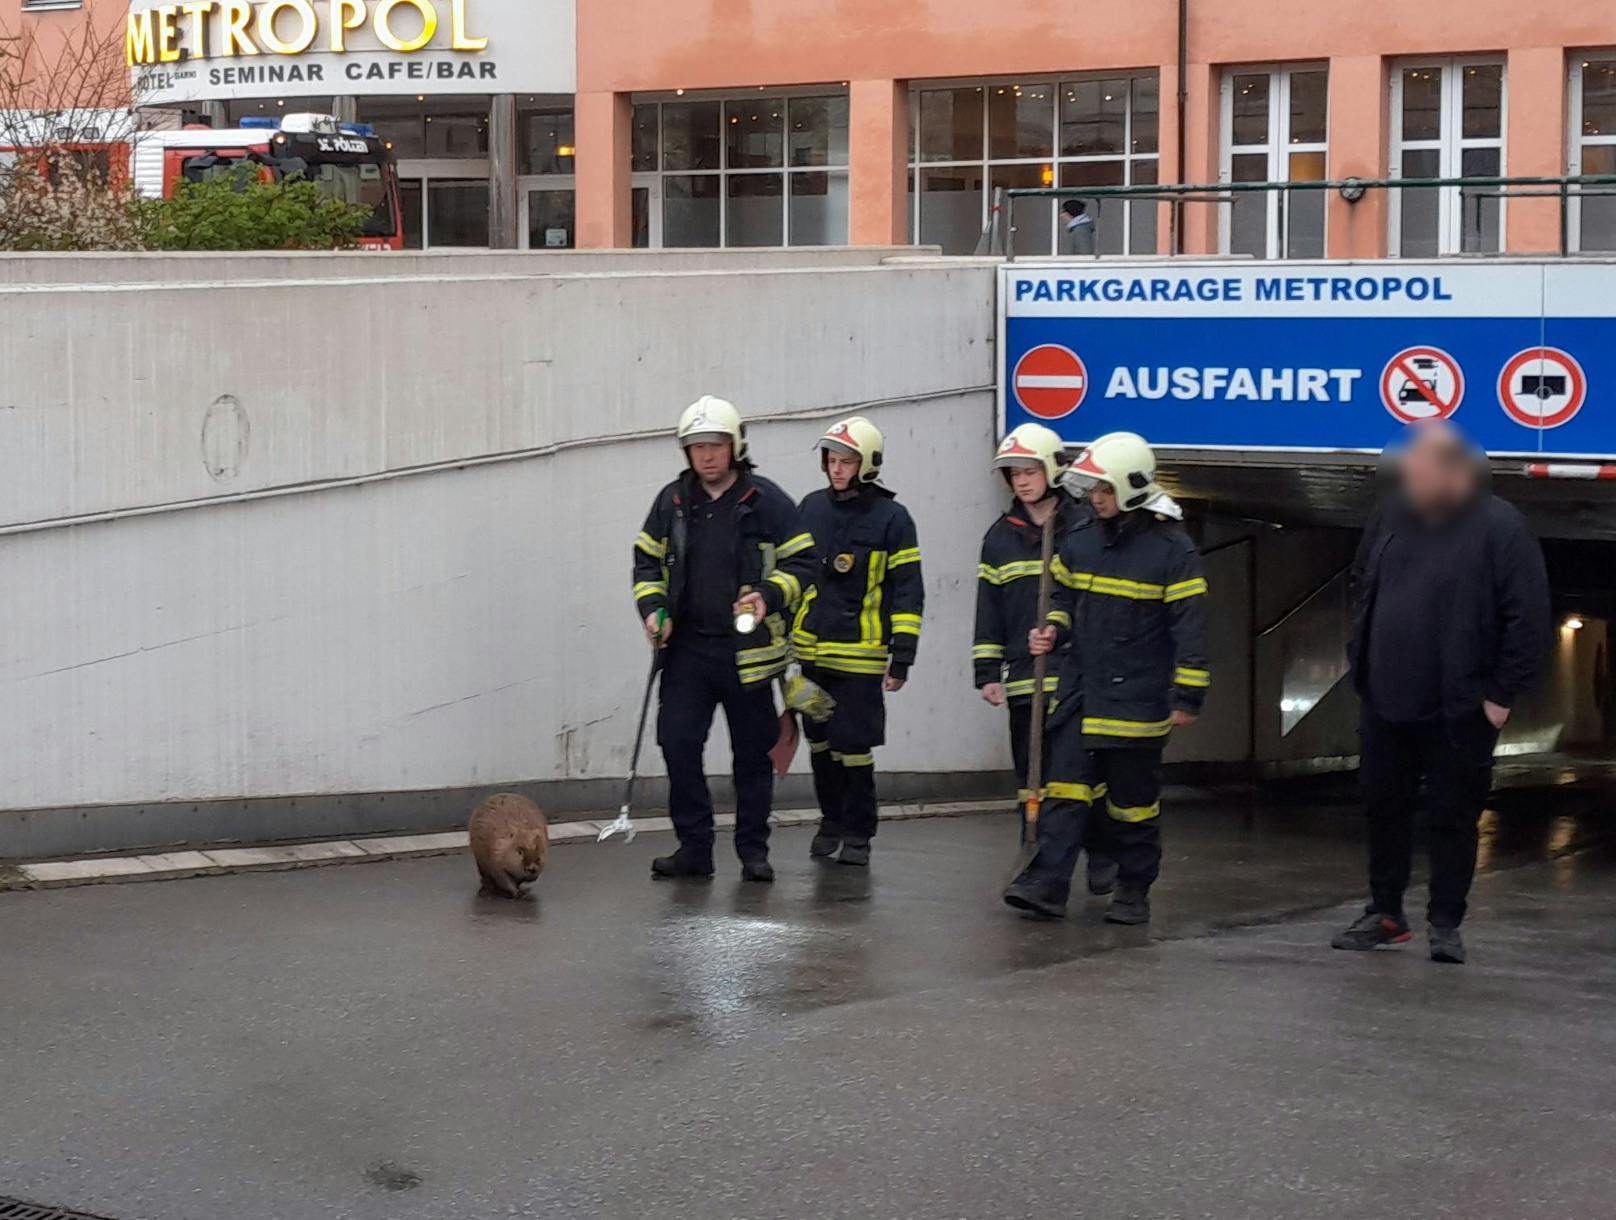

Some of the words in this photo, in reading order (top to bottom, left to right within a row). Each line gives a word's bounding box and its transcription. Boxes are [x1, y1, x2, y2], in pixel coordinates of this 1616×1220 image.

[127, 0, 489, 65] METROPOL
[209, 63, 324, 86] SEMINAR
[345, 61, 497, 80] CAFE/BAR
[1015, 279, 1242, 301] PARKGARAGE
[1255, 277, 1452, 301] METROPOL
[1104, 366, 1362, 401] AUSFAHRT
